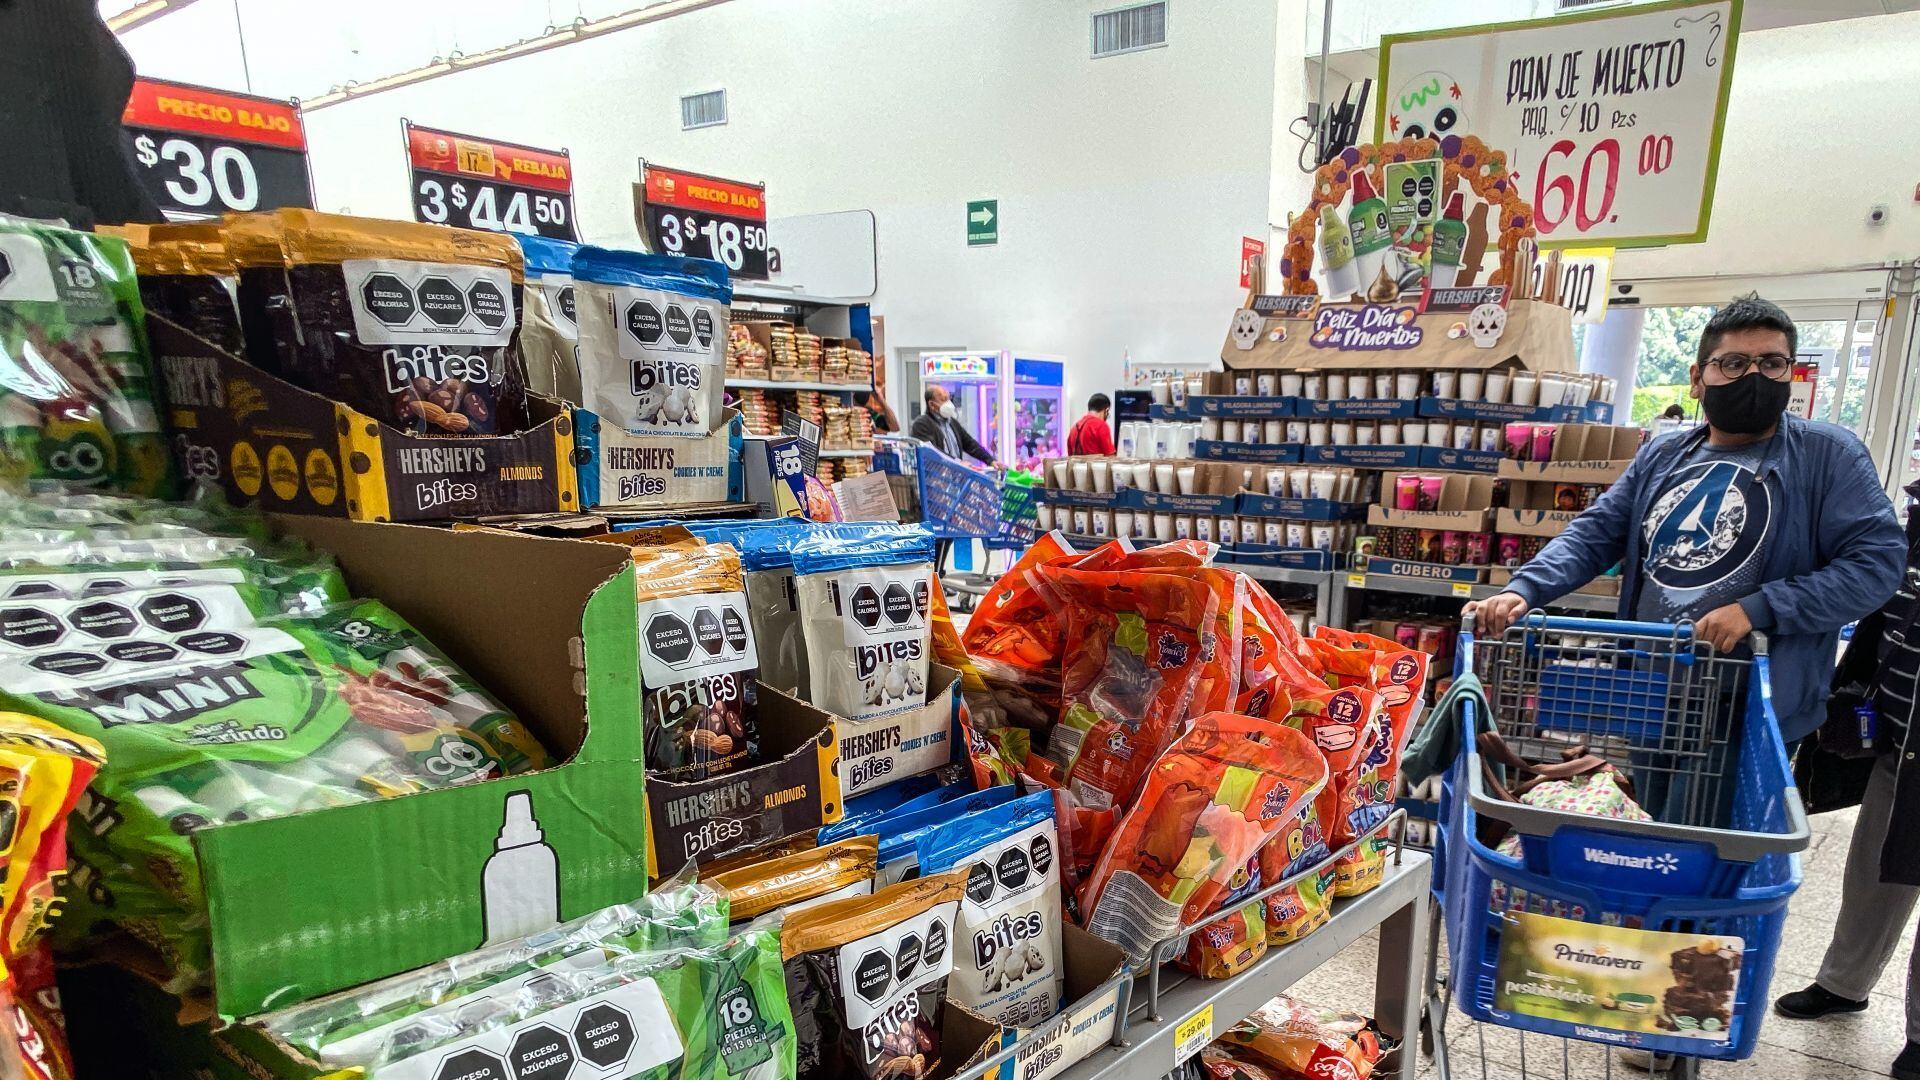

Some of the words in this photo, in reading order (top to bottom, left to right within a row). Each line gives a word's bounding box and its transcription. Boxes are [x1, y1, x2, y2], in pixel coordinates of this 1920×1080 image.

[1506, 53, 1551, 105] PAN
[1556, 50, 1583, 100] DE
[1592, 38, 1685, 98] MUERTO
[158, 96, 232, 123] PRECIO
[238, 110, 290, 132] BAJO
[1579, 102, 1600, 133] 10
[1638, 134, 1673, 176] 00
[512, 158, 567, 181] REBAJA
[419, 180, 448, 223] 3
[688, 185, 728, 204] PRECIO
[731, 193, 759, 209] BAJO
[661, 214, 683, 251] 3
[744, 226, 767, 252] 50
[60, 264, 96, 289] 18
[373, 290, 403, 299] EXCESO
[424, 301, 462, 310] AZÚCARES
[426, 293, 456, 301] EXCESO
[476, 292, 499, 301] EXCESO
[477, 300, 501, 309] GRASAS
[634, 314, 656, 322] EXCESO
[1315, 309, 1356, 331] Feliz
[1363, 307, 1394, 328] Día
[1328, 331, 1342, 342] de
[1344, 326, 1421, 347] Muertos
[383, 345, 488, 393] bites
[629, 359, 702, 397] bites
[400, 447, 486, 475] HERSHEY'S
[610, 447, 675, 471] HERSHEY'S
[774, 450, 785, 477] PIEZAS
[780, 444, 802, 476] 18
[500, 466, 543, 482] ALMONDS
[674, 467, 697, 478] COOKIES
[706, 467, 724, 477] CREME
[417, 479, 478, 511] bites
[619, 473, 667, 501] bites
[1391, 563, 1453, 579] CUBERO
[887, 604, 911, 612] AZÚCARES
[655, 628, 682, 640] EXCESO
[655, 637, 689, 649] CALORÍAS
[1397, 665, 1411, 675] 12
[92, 676, 249, 723] MINI
[657, 674, 737, 728] bites
[1337, 702, 1354, 717] 12
[843, 725, 901, 761] HERSHEY'S
[900, 737, 922, 752] COOKIES
[930, 730, 947, 745] CREME
[850, 756, 893, 791] bites
[667, 781, 751, 828] HERSHEY'S
[764, 784, 807, 809] ALMONDS
[684, 820, 743, 860] bites
[1001, 858, 1023, 871] EXCESO
[1584, 848, 1653, 870] Walmart
[968, 872, 987, 885] EXCESO
[1000, 865, 1028, 880] AZÚCARES
[968, 879, 992, 893] CALORÍAS
[973, 911, 1043, 970] bites
[1554, 943, 1644, 970] Primavera
[861, 972, 889, 989] CALORÍAS
[863, 964, 887, 979] EXCESO
[979, 999, 994, 1011] SABOR
[998, 987, 1022, 1002] CHOCOLATE
[720, 997, 753, 1030] 18
[585, 1021, 620, 1040] EXCESO
[592, 1033, 620, 1050] SODIO
[724, 1024, 757, 1044] PIEZAS
[1575, 1026, 1627, 1043] Walmart
[522, 1042, 559, 1062] EXCESO
[721, 1047, 732, 1056] de
[734, 1040, 745, 1052] 13
[747, 1039, 753, 1048] g
[754, 1032, 767, 1044] c/u
[520, 1052, 569, 1077] AZÚCARES
[1023, 1044, 1063, 1080] bites
